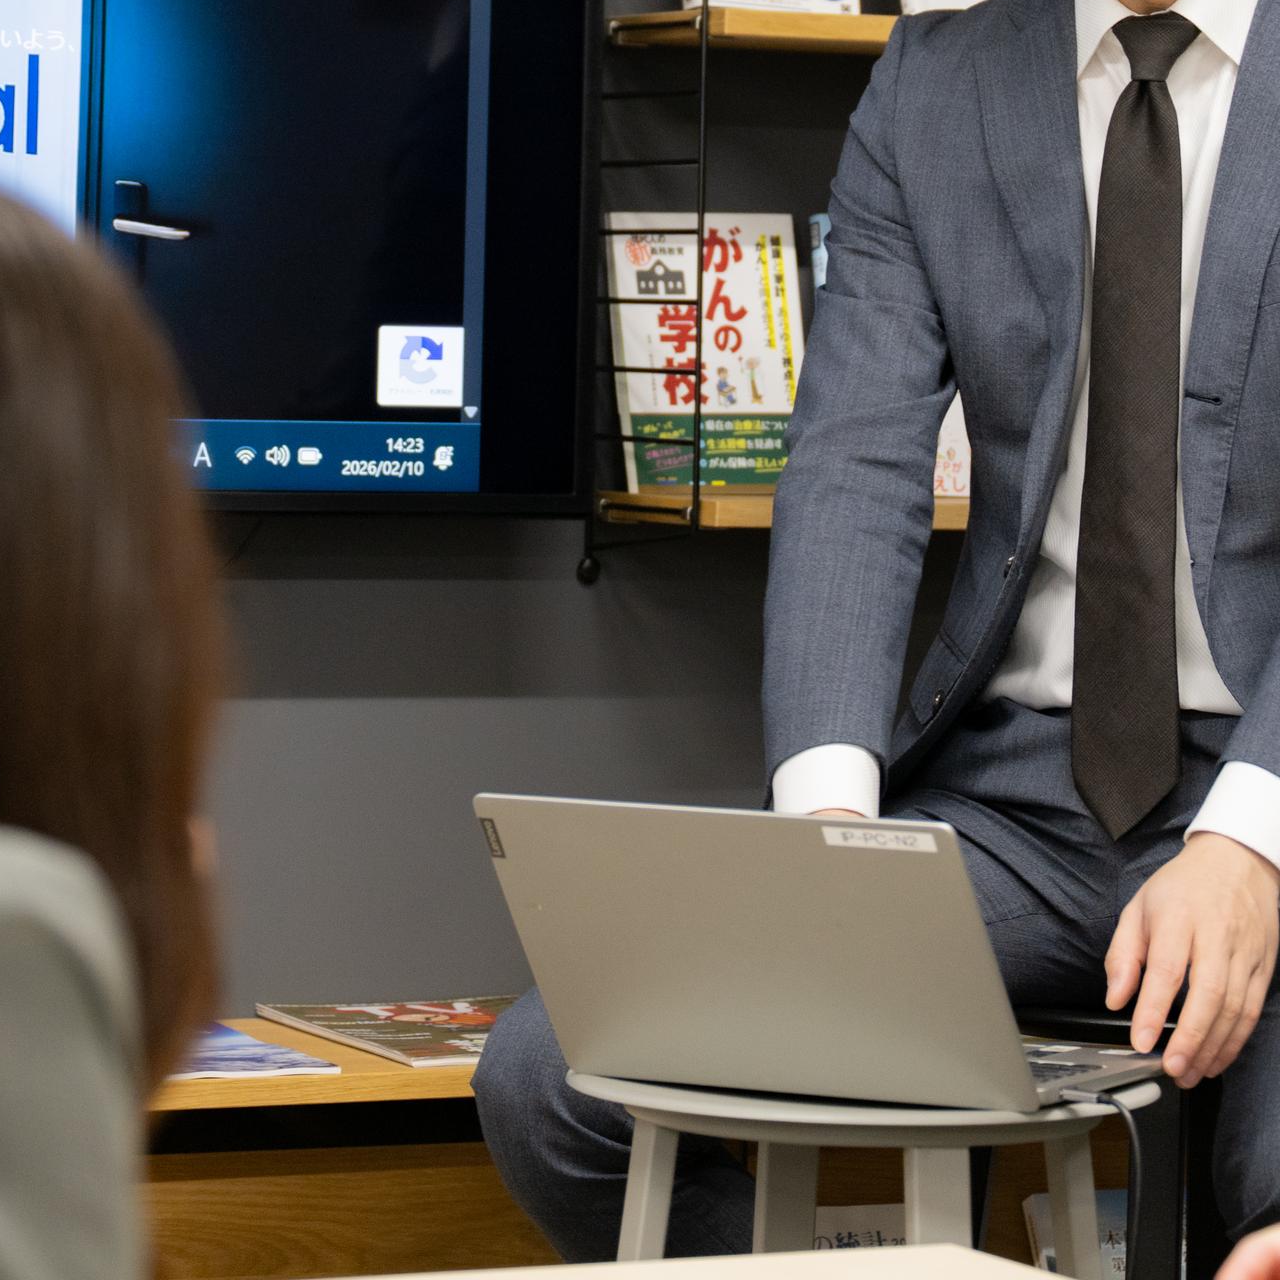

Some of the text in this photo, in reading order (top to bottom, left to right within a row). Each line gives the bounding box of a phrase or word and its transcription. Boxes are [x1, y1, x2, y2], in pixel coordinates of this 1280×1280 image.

[702, 226, 748, 353] がんの
[192, 441, 213, 468] A
[385, 437, 425, 454] 14:23
[341, 460, 425, 478] 2026/02/10
